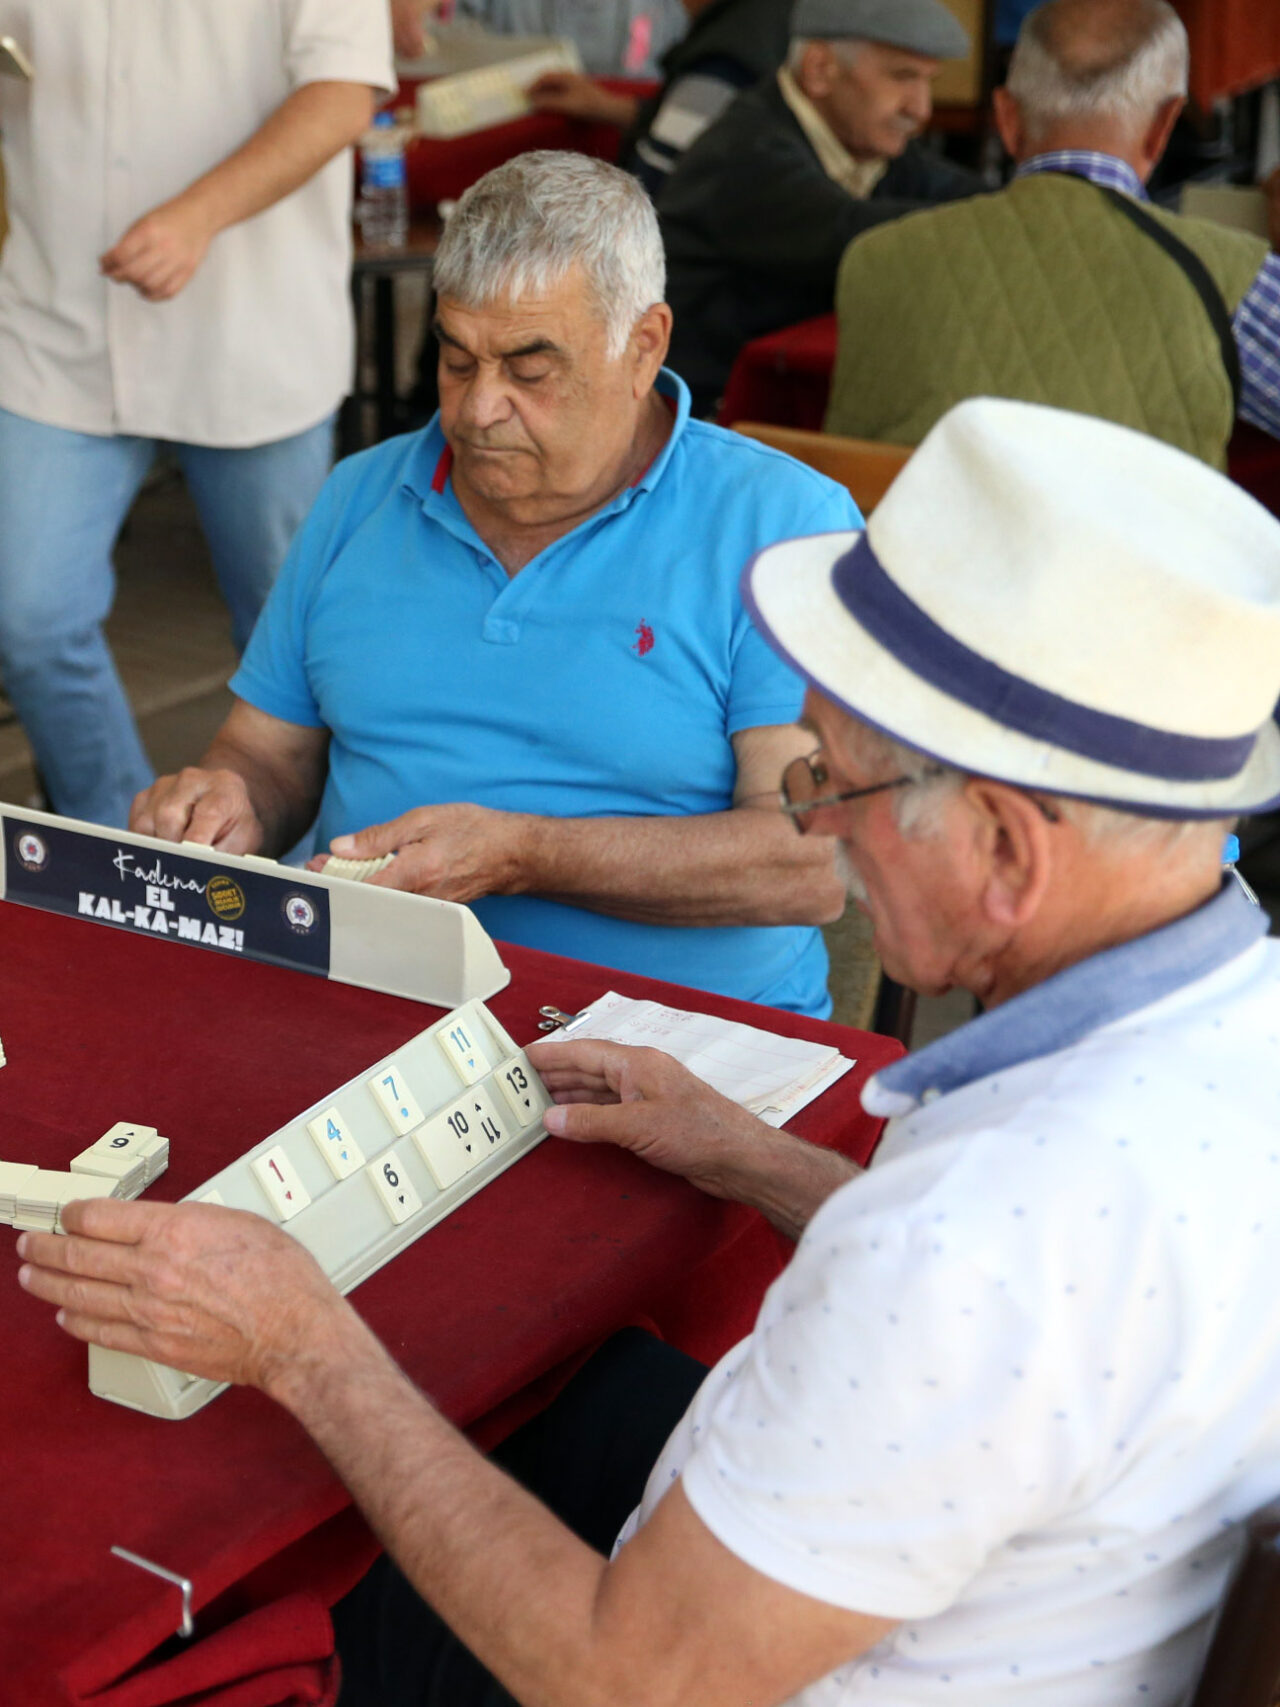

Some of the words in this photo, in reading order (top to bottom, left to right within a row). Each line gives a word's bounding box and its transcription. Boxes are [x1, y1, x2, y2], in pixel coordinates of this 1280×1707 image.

[145, 884, 175, 912] EL
[77, 891, 244, 952] KAL-KA-MAZ!
[449, 1025, 472, 1053] 11
[381, 1075, 400, 1101] 7
[506, 1066, 528, 1094] 13
[326, 1118, 343, 1142] 4
[447, 1111, 469, 1139] 10
[269, 1159, 285, 1182] 1
[382, 1162, 400, 1188] 6
